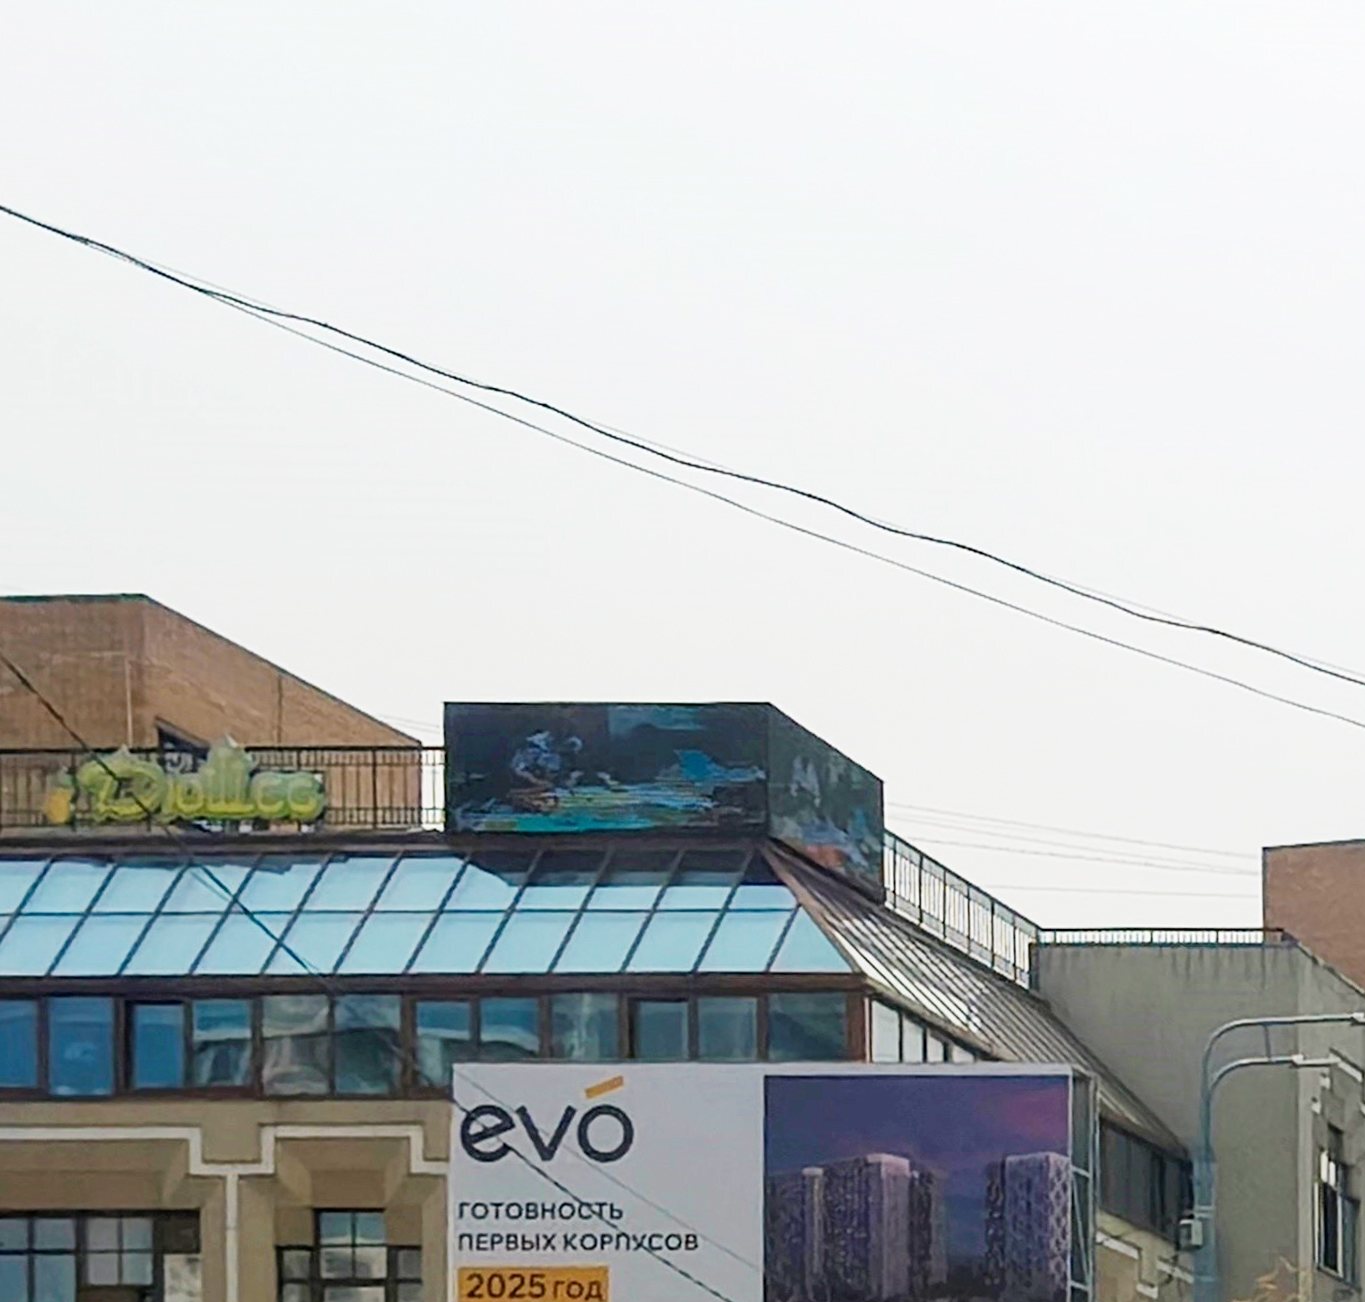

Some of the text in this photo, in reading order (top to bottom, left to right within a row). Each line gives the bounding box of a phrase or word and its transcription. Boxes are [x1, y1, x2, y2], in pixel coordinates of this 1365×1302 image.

[458, 1201, 624, 1221] ГОТОВНОСТЬ
[458, 1233, 699, 1251] ПЕРВЫХ КОРПУСОВ
[467, 1273, 604, 1301] 2025 год
